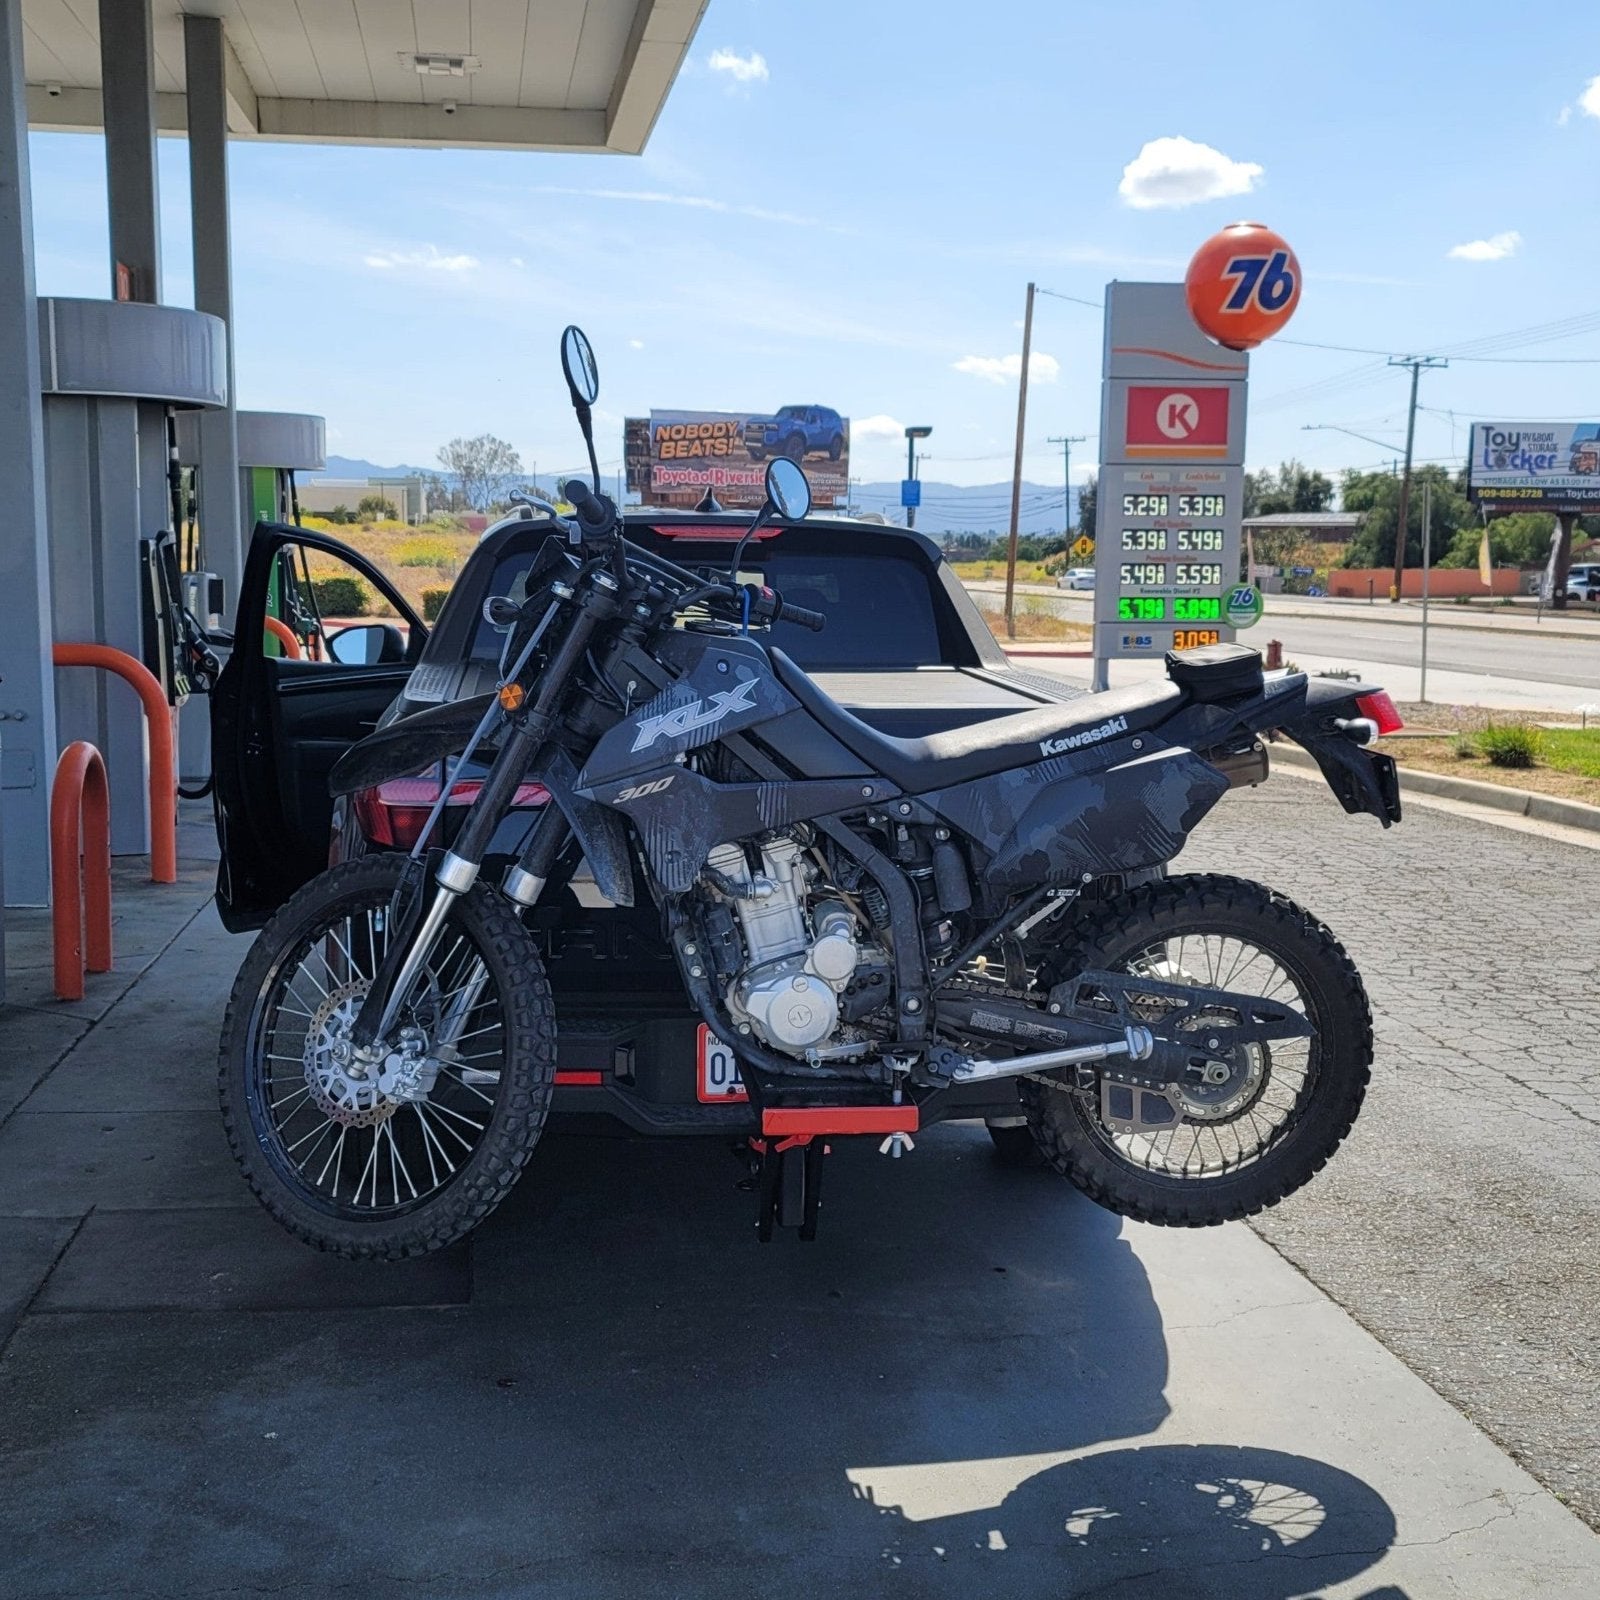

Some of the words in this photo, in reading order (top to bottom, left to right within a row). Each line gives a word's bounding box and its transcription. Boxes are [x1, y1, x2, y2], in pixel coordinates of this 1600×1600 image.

[1219, 250, 1296, 314] 76
[655, 421, 739, 441] NOBODY
[1167, 404, 1196, 433] K
[659, 438, 735, 459] BEATS!
[1481, 426, 1520, 452] Toy
[654, 465, 700, 486] Toyota
[713, 468, 766, 486] Riversi
[1231, 587, 1254, 605] 76
[631, 677, 761, 753] KLX
[1039, 715, 1128, 757] Kawasaki
[613, 775, 675, 804] 300
[711, 1052, 743, 1085] 01
